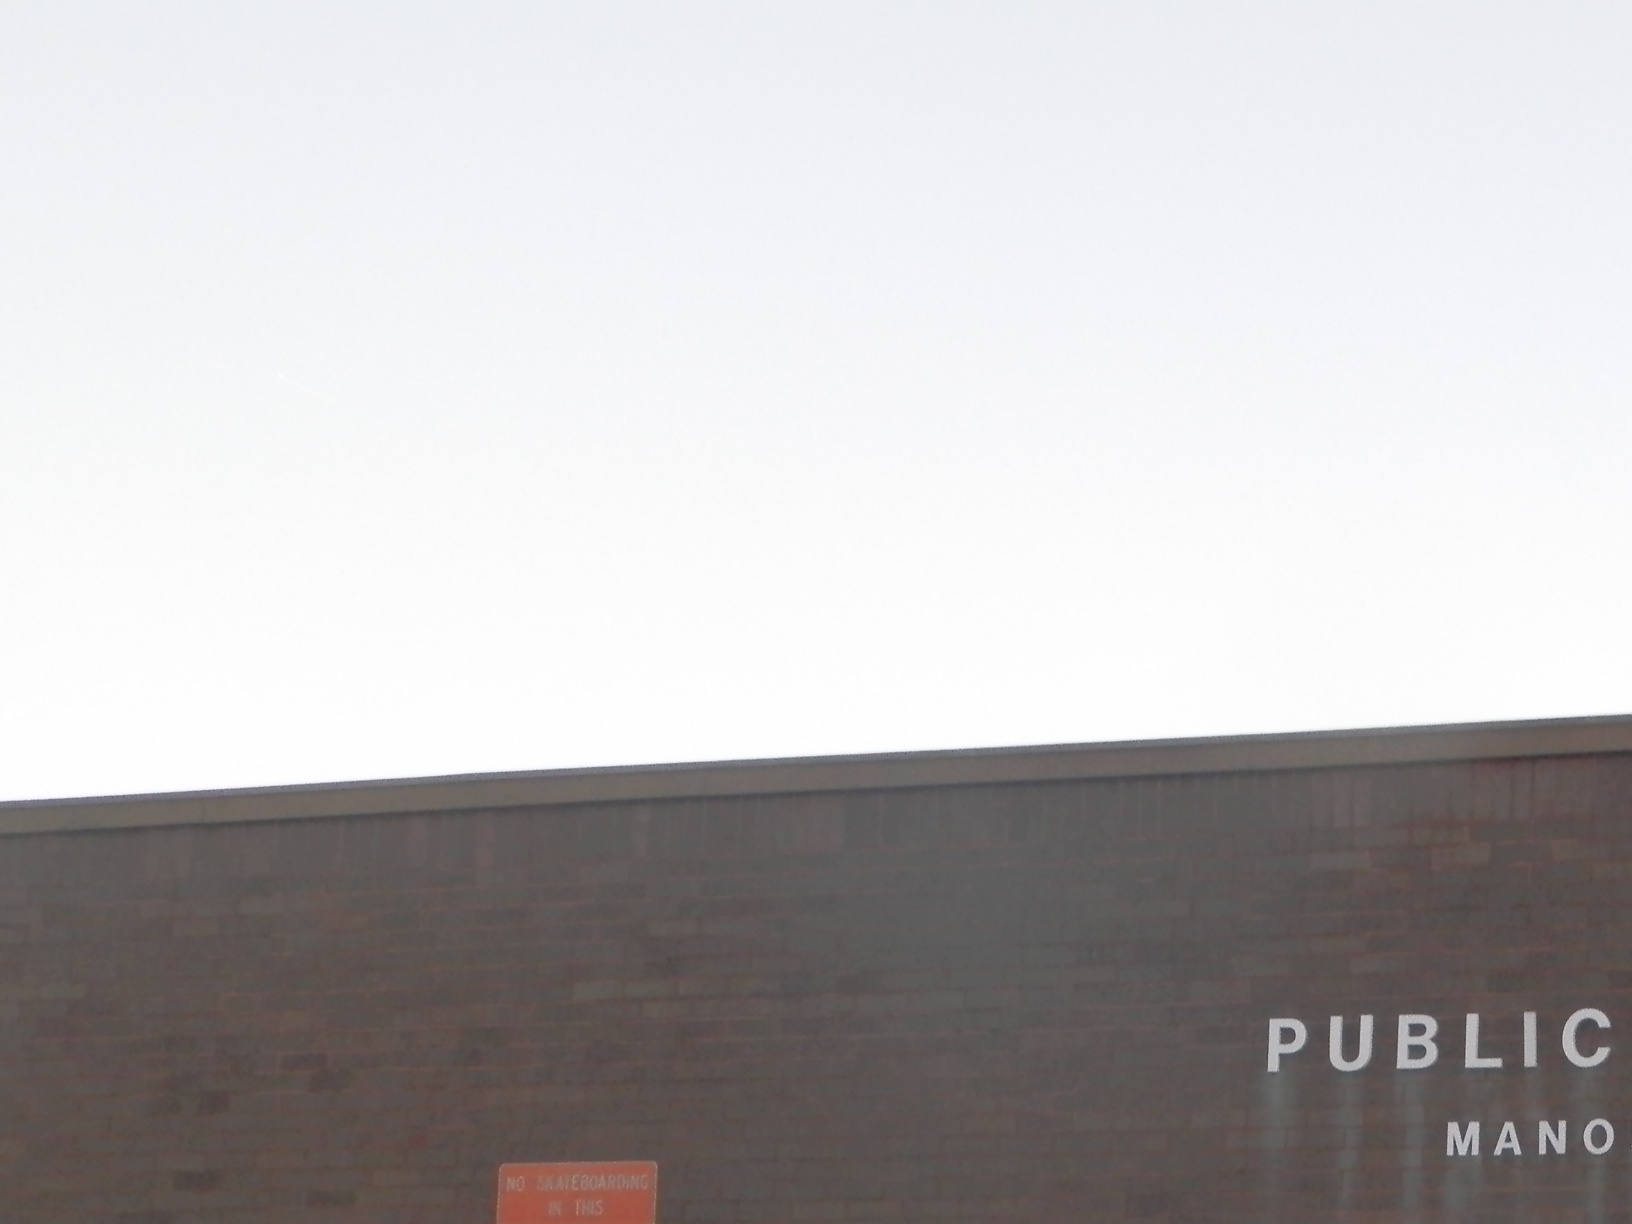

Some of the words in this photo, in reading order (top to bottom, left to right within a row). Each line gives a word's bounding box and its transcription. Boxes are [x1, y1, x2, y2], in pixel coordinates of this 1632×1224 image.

[1266, 1007, 1612, 1073] PUBLIC
[506, 1175, 525, 1191] NO
[537, 1173, 648, 1191] SKATEBOARDING
[549, 1201, 562, 1216] IN
[575, 1200, 603, 1216] THIS
